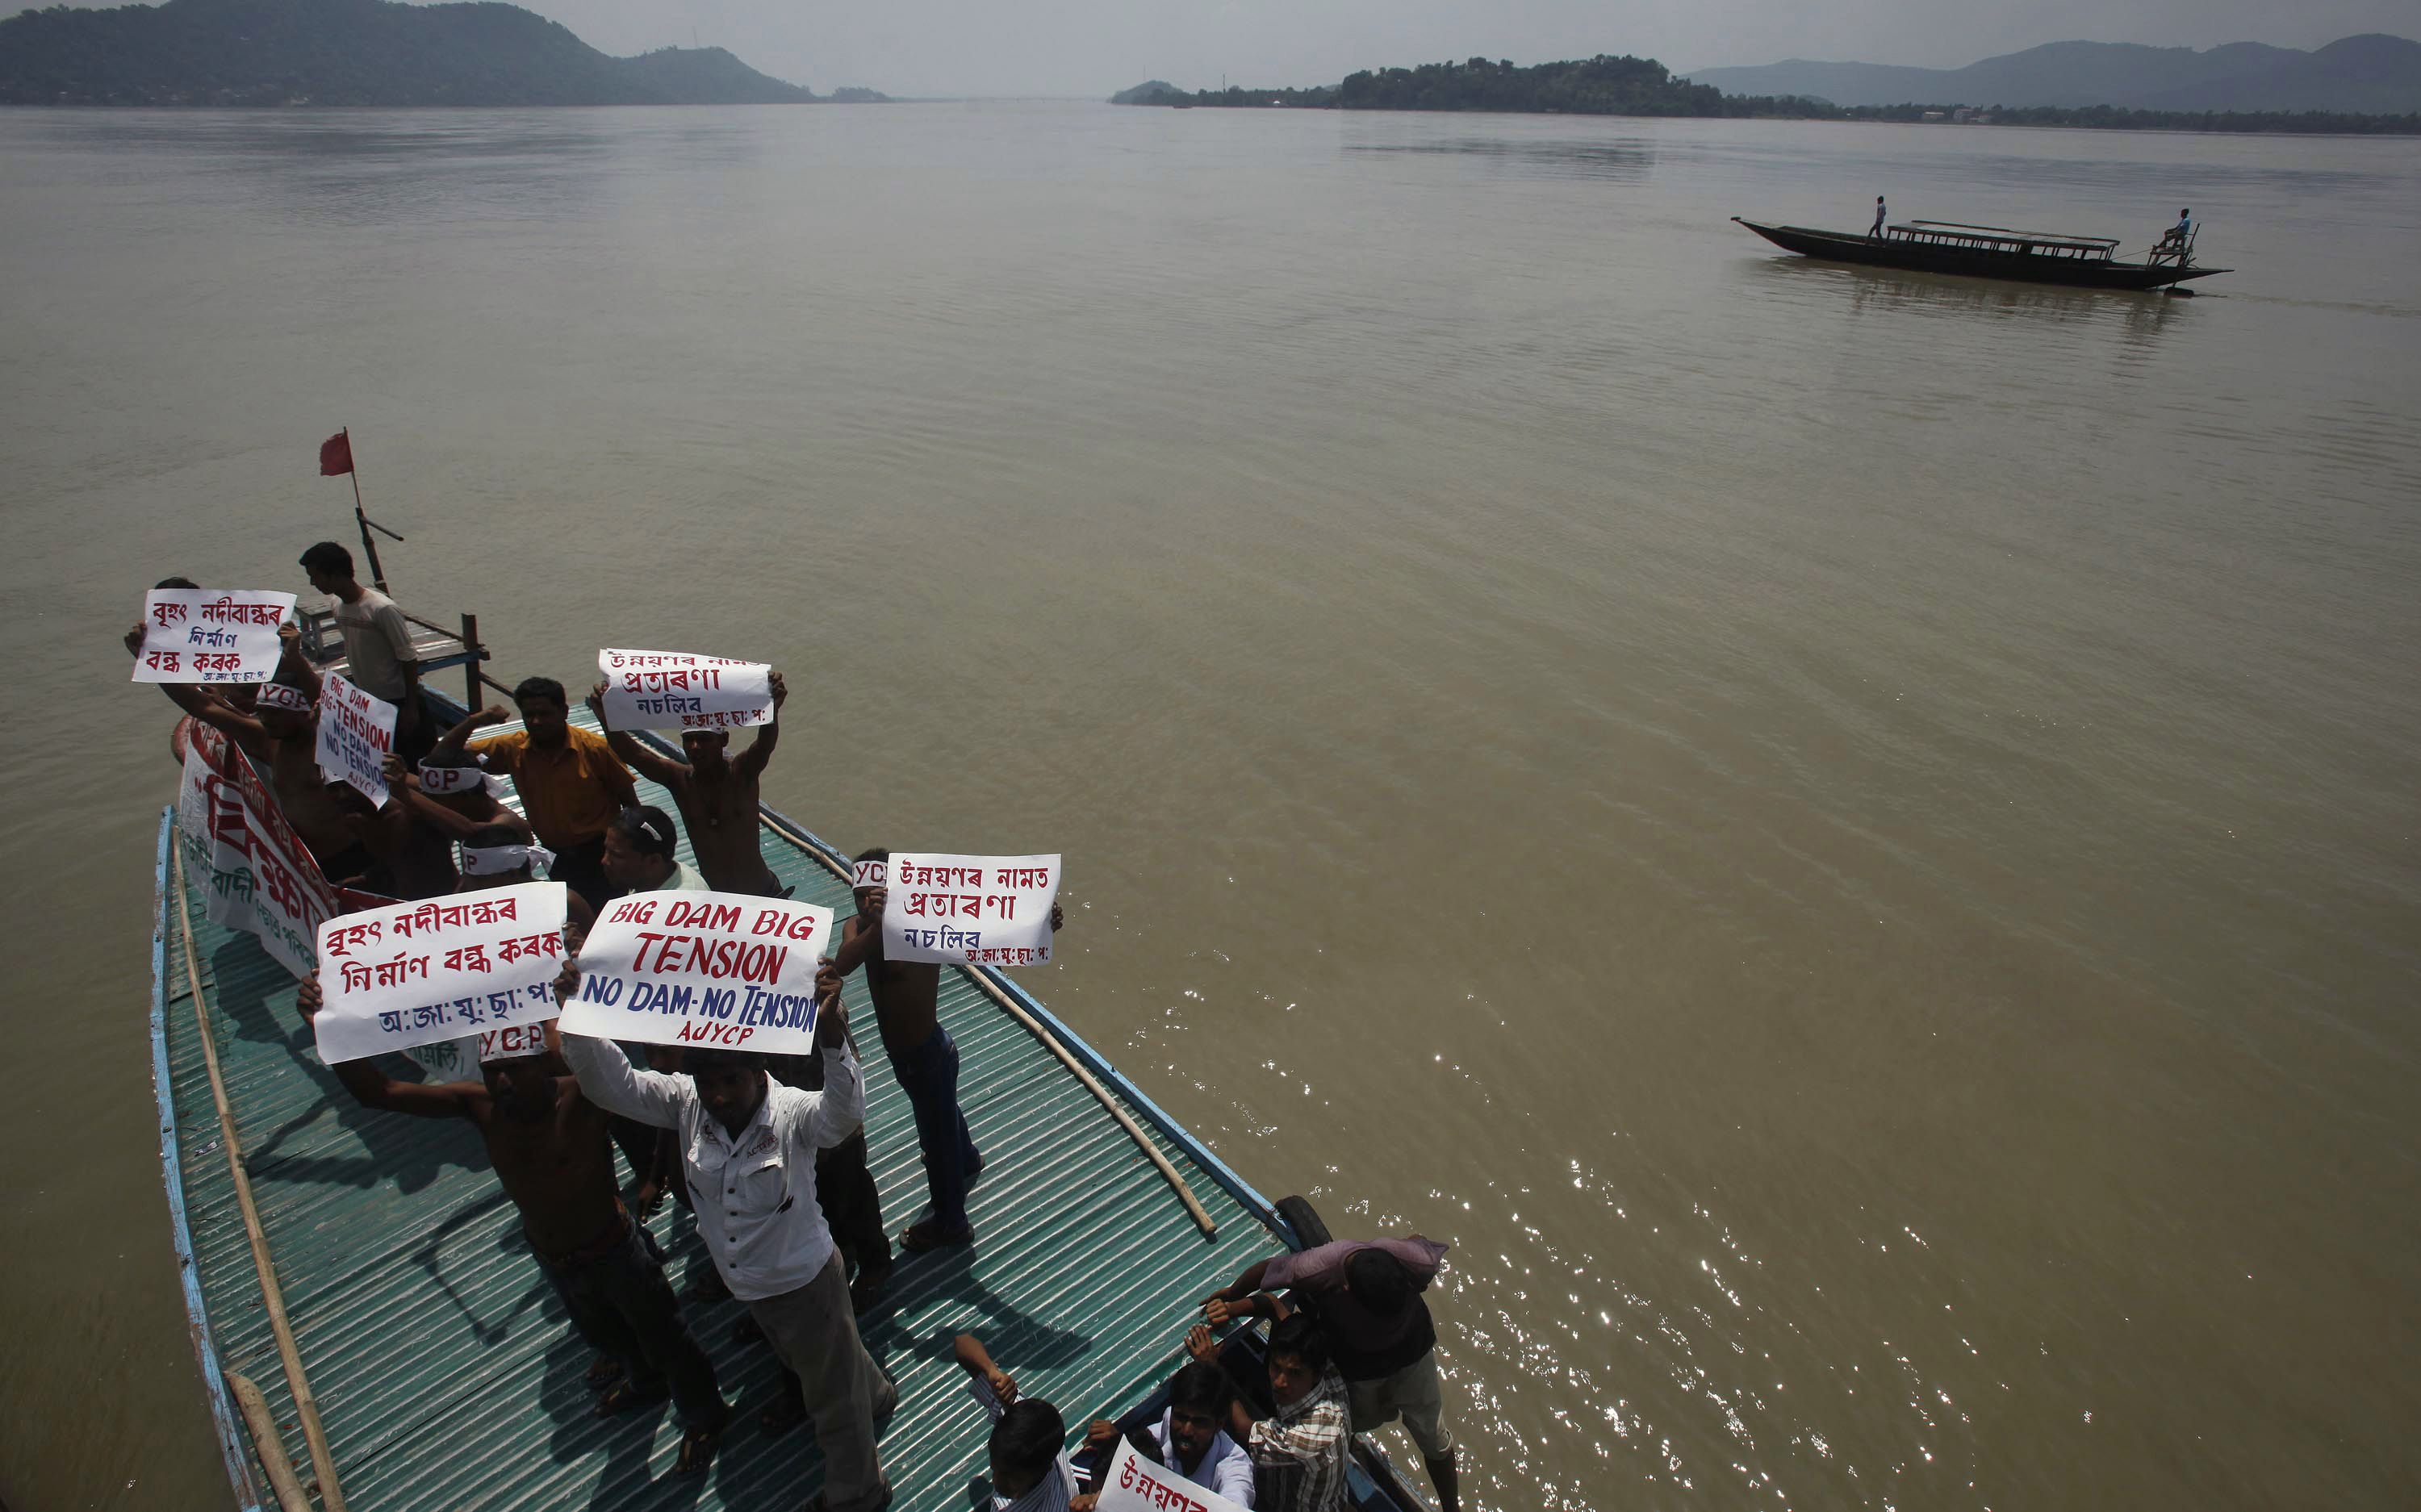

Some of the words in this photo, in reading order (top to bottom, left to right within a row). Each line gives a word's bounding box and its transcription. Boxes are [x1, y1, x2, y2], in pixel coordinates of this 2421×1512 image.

[331, 676, 344, 697] BIG
[349, 690, 370, 712] DAM
[325, 733, 339, 756] NO
[333, 720, 347, 740] NO
[350, 733, 370, 760] DAM
[420, 770, 459, 791] CP
[856, 863, 887, 883] YC
[997, 867, 1048, 889] নামত
[608, 900, 658, 925] BIG
[665, 900, 742, 933] DAM
[751, 910, 815, 941] BIG
[326, 921, 381, 956] বৃহৎ
[444, 944, 491, 973] বন্ধ
[632, 931, 788, 986] TENSION
[583, 974, 623, 1006] NO
[738, 985, 818, 1033] TENSION
[676, 1020, 754, 1046] AJYCP
